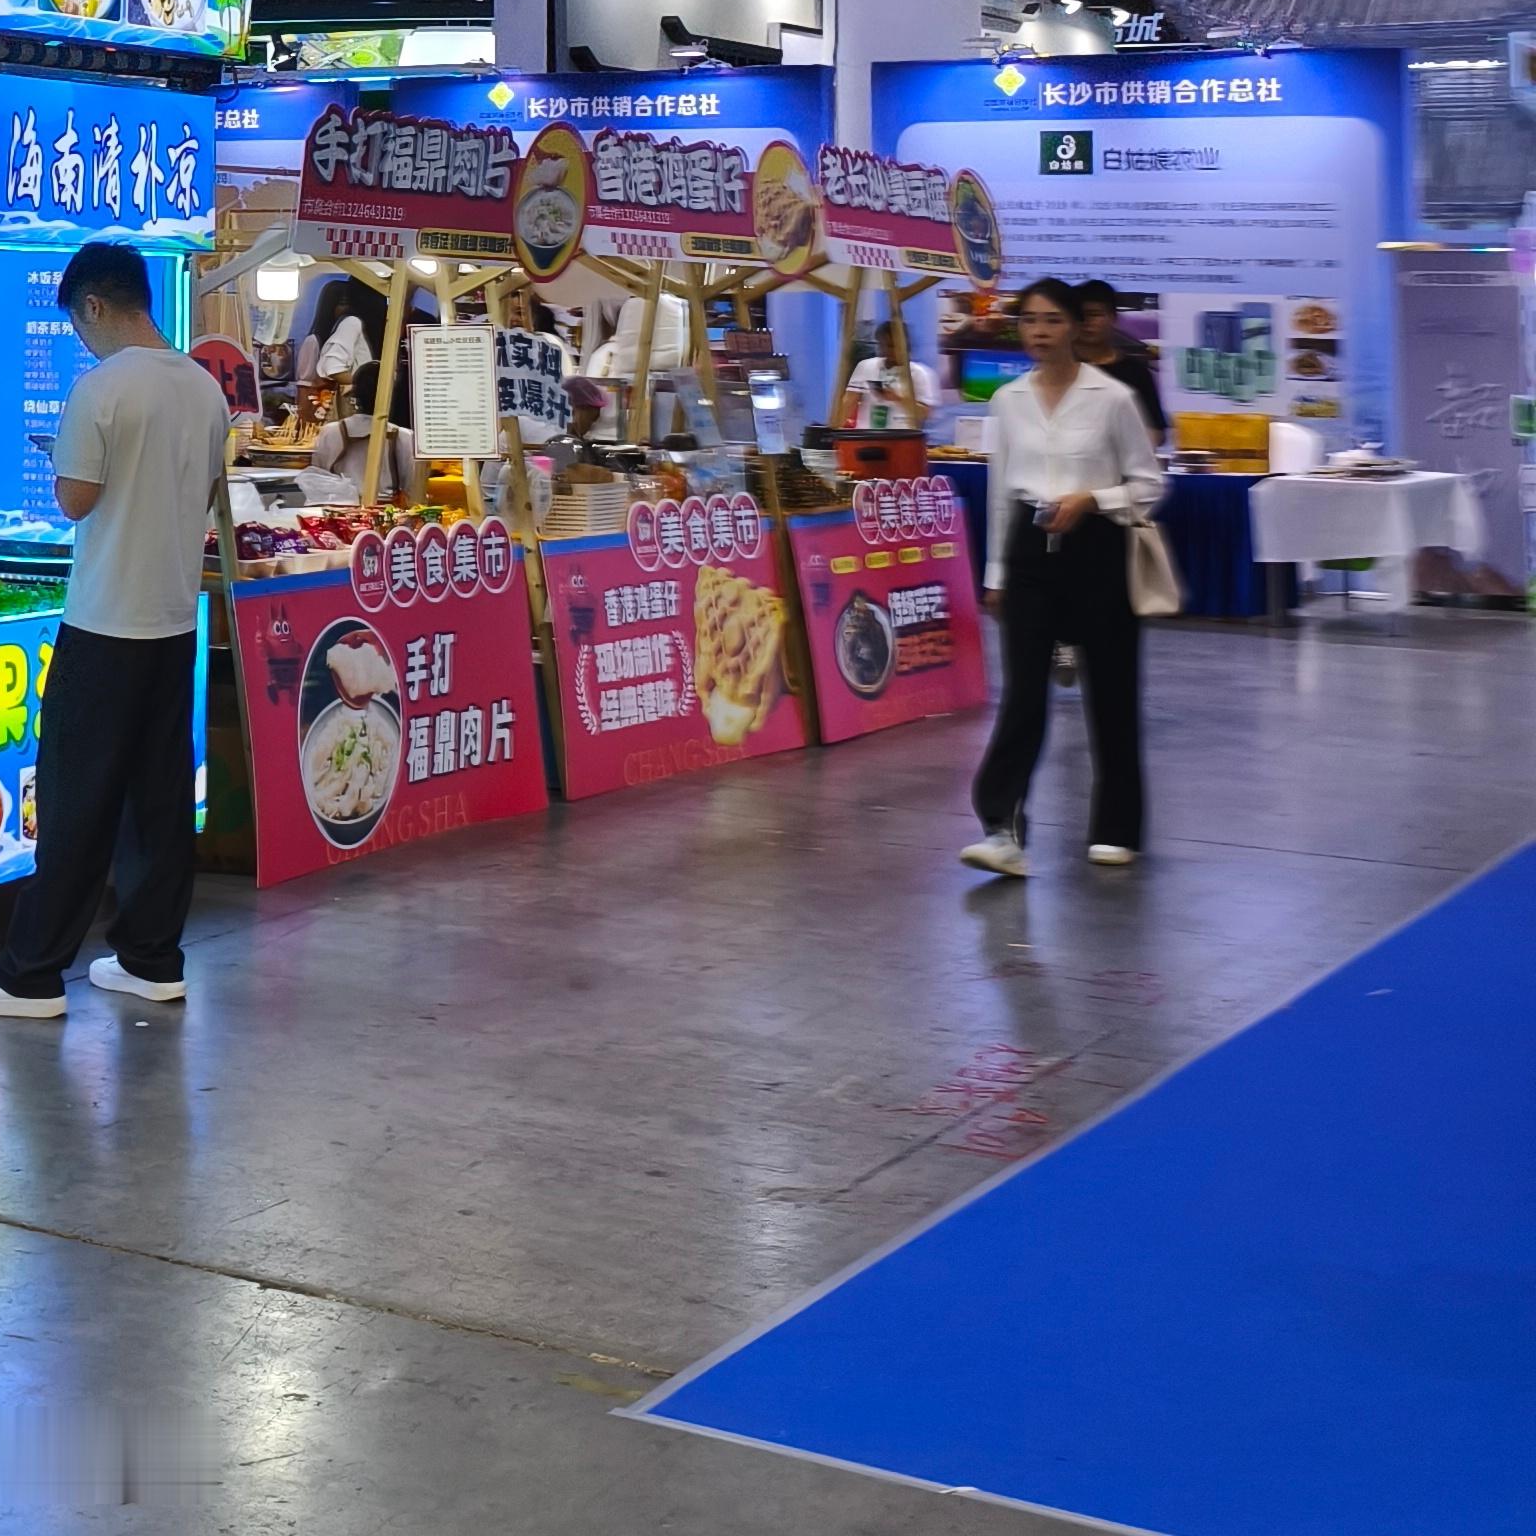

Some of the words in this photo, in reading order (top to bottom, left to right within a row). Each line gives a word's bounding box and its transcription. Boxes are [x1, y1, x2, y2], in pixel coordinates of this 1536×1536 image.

[527, 93, 721, 119] 长沙市供销合作总社
[1043, 76, 1283, 106] 长沙市供销合作总社
[7, 106, 201, 224] 海南清补凉
[312, 113, 516, 199] 手打福鼎肉片
[594, 134, 747, 213] 香港鸡蛋仔
[822, 150, 951, 224] 老长沙臭豆腐
[24, 399, 66, 415] 烧仙草
[659, 504, 758, 555] 美食集市
[877, 489, 955, 529] 美食集市
[390, 530, 508, 593] 美食集市
[604, 580, 681, 627] 香港鸡蛋仔
[405, 633, 456, 702] 手打
[405, 698, 516, 783] 福鼎肉片
